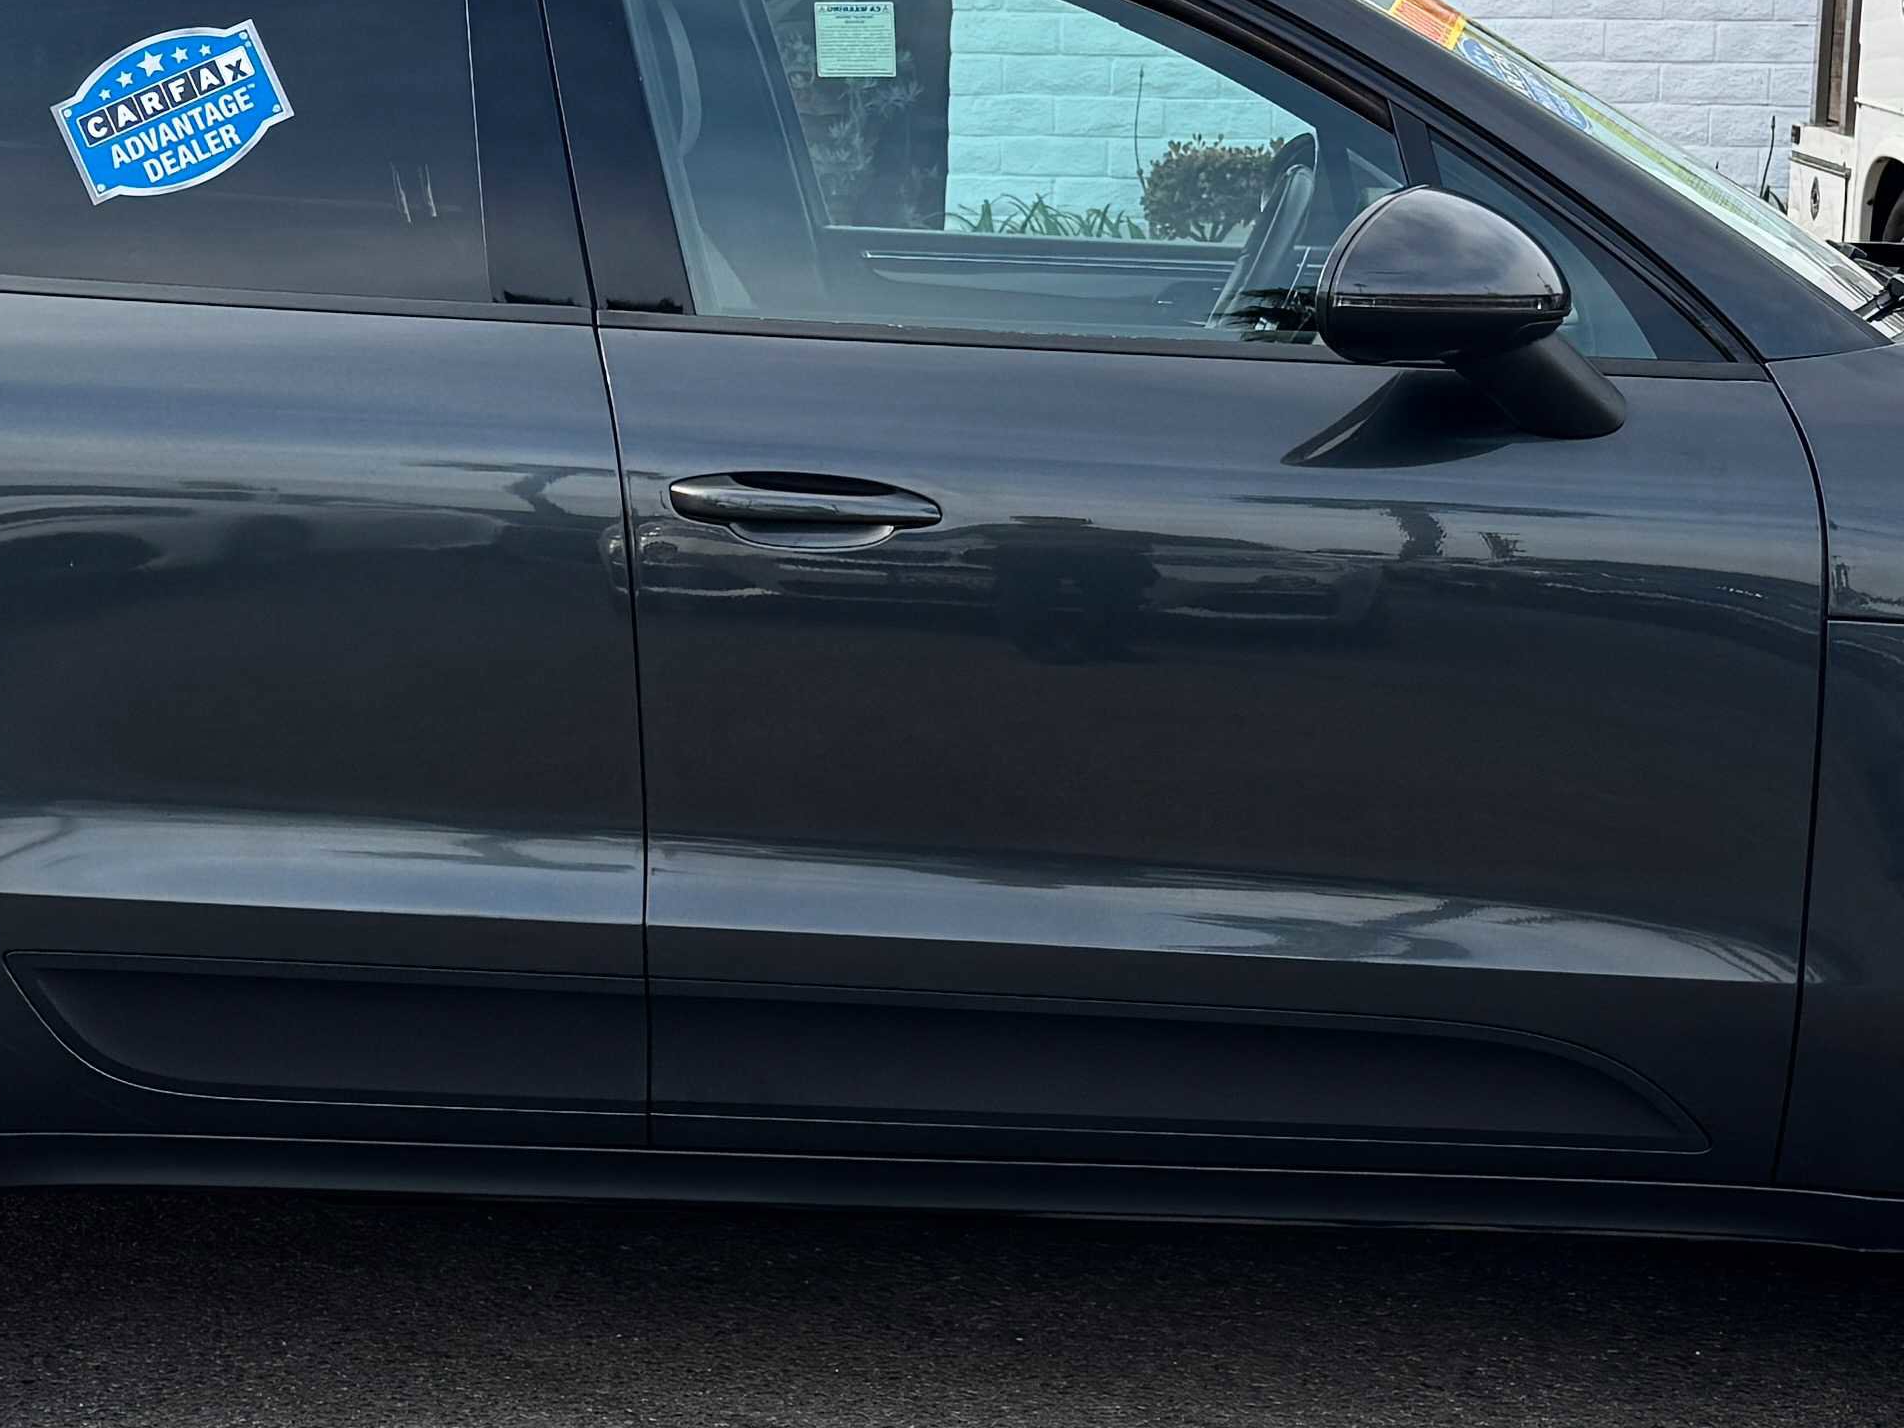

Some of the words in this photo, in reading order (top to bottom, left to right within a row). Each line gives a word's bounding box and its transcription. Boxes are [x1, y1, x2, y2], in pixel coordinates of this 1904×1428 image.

[87, 60, 252, 139] CARFAX
[109, 89, 254, 169] ADVANTAGE
[143, 123, 242, 183] DEALER
